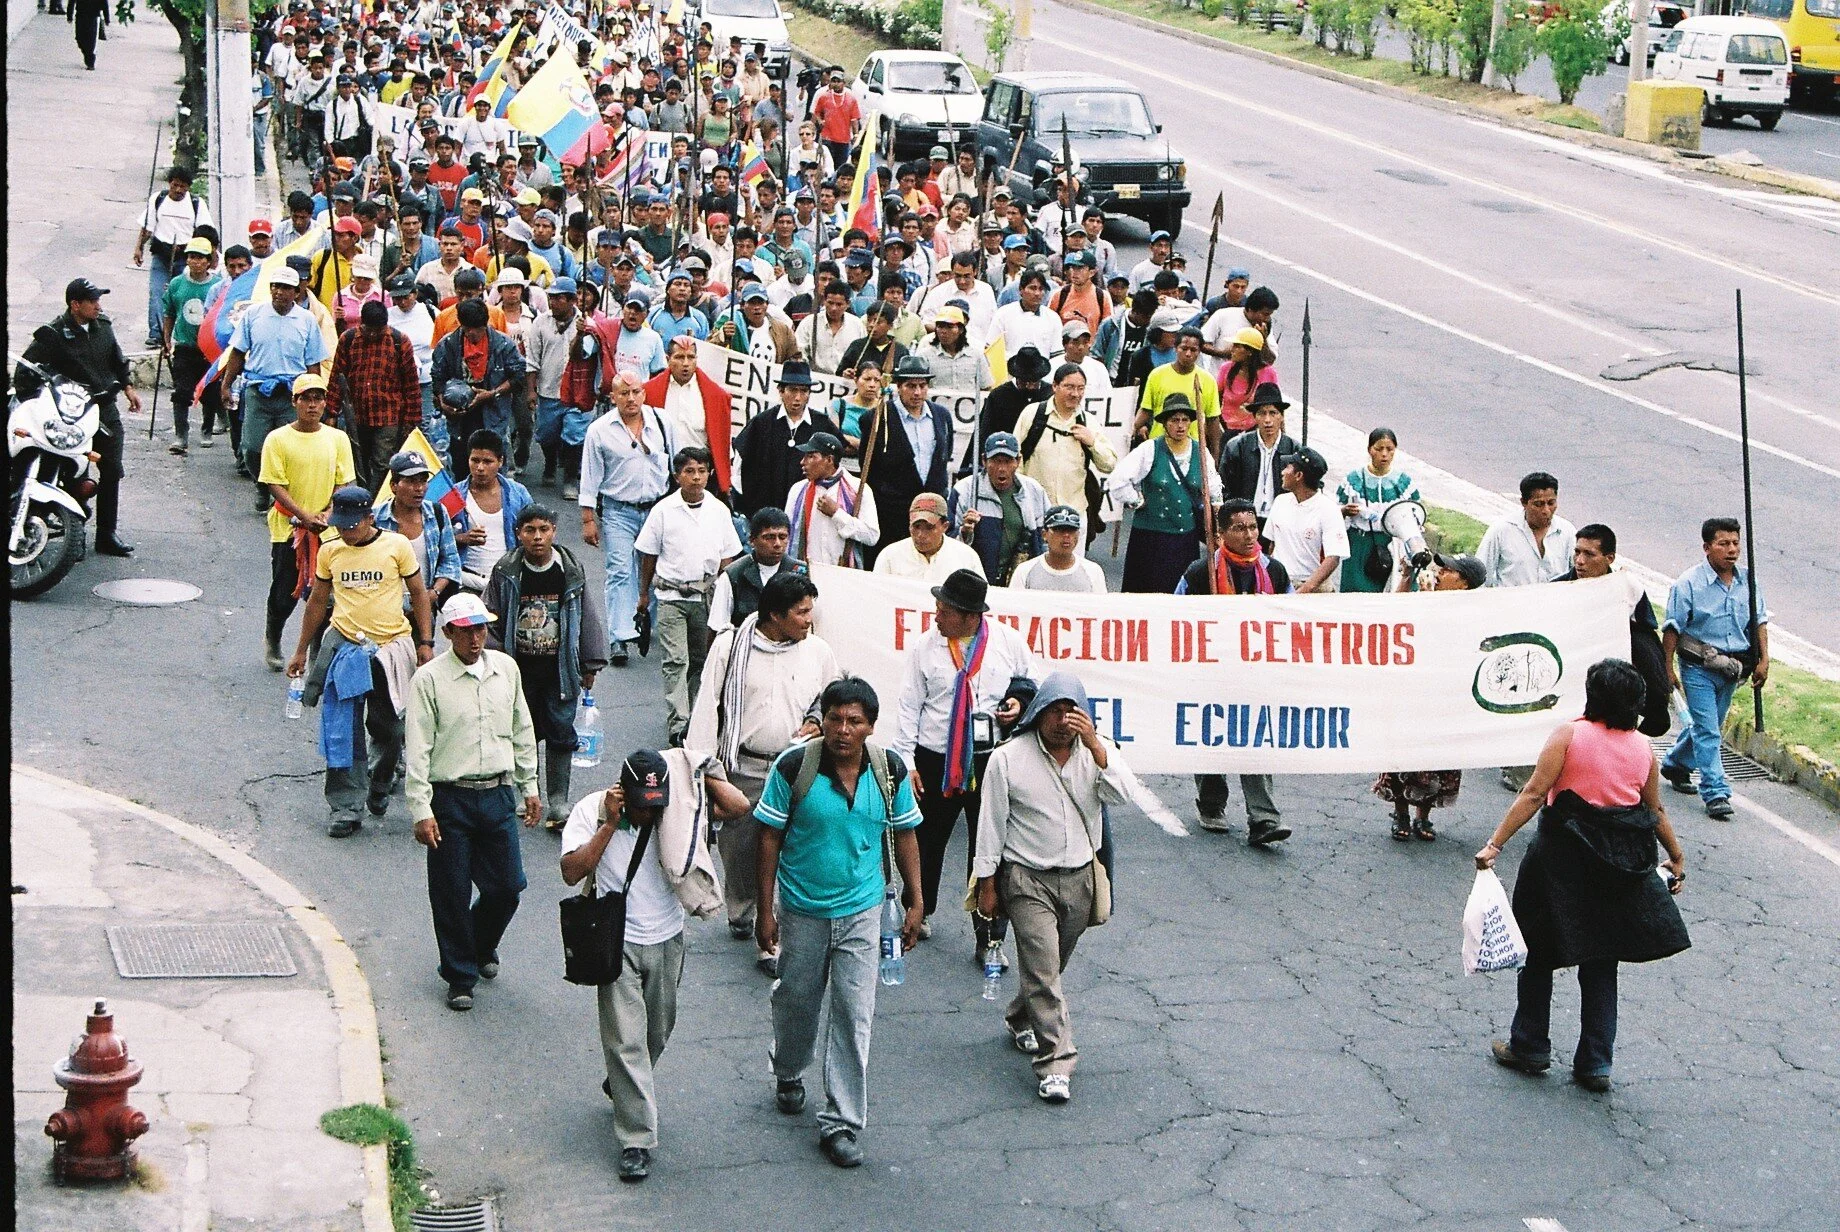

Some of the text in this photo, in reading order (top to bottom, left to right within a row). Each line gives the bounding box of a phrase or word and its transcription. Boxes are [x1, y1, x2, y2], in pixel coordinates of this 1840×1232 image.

[725, 357, 771, 395] EN
[341, 571, 384, 582] DEMO
[895, 607, 1415, 666] FACION DE CENTROS
[1175, 703, 1351, 749] ECUADOR
